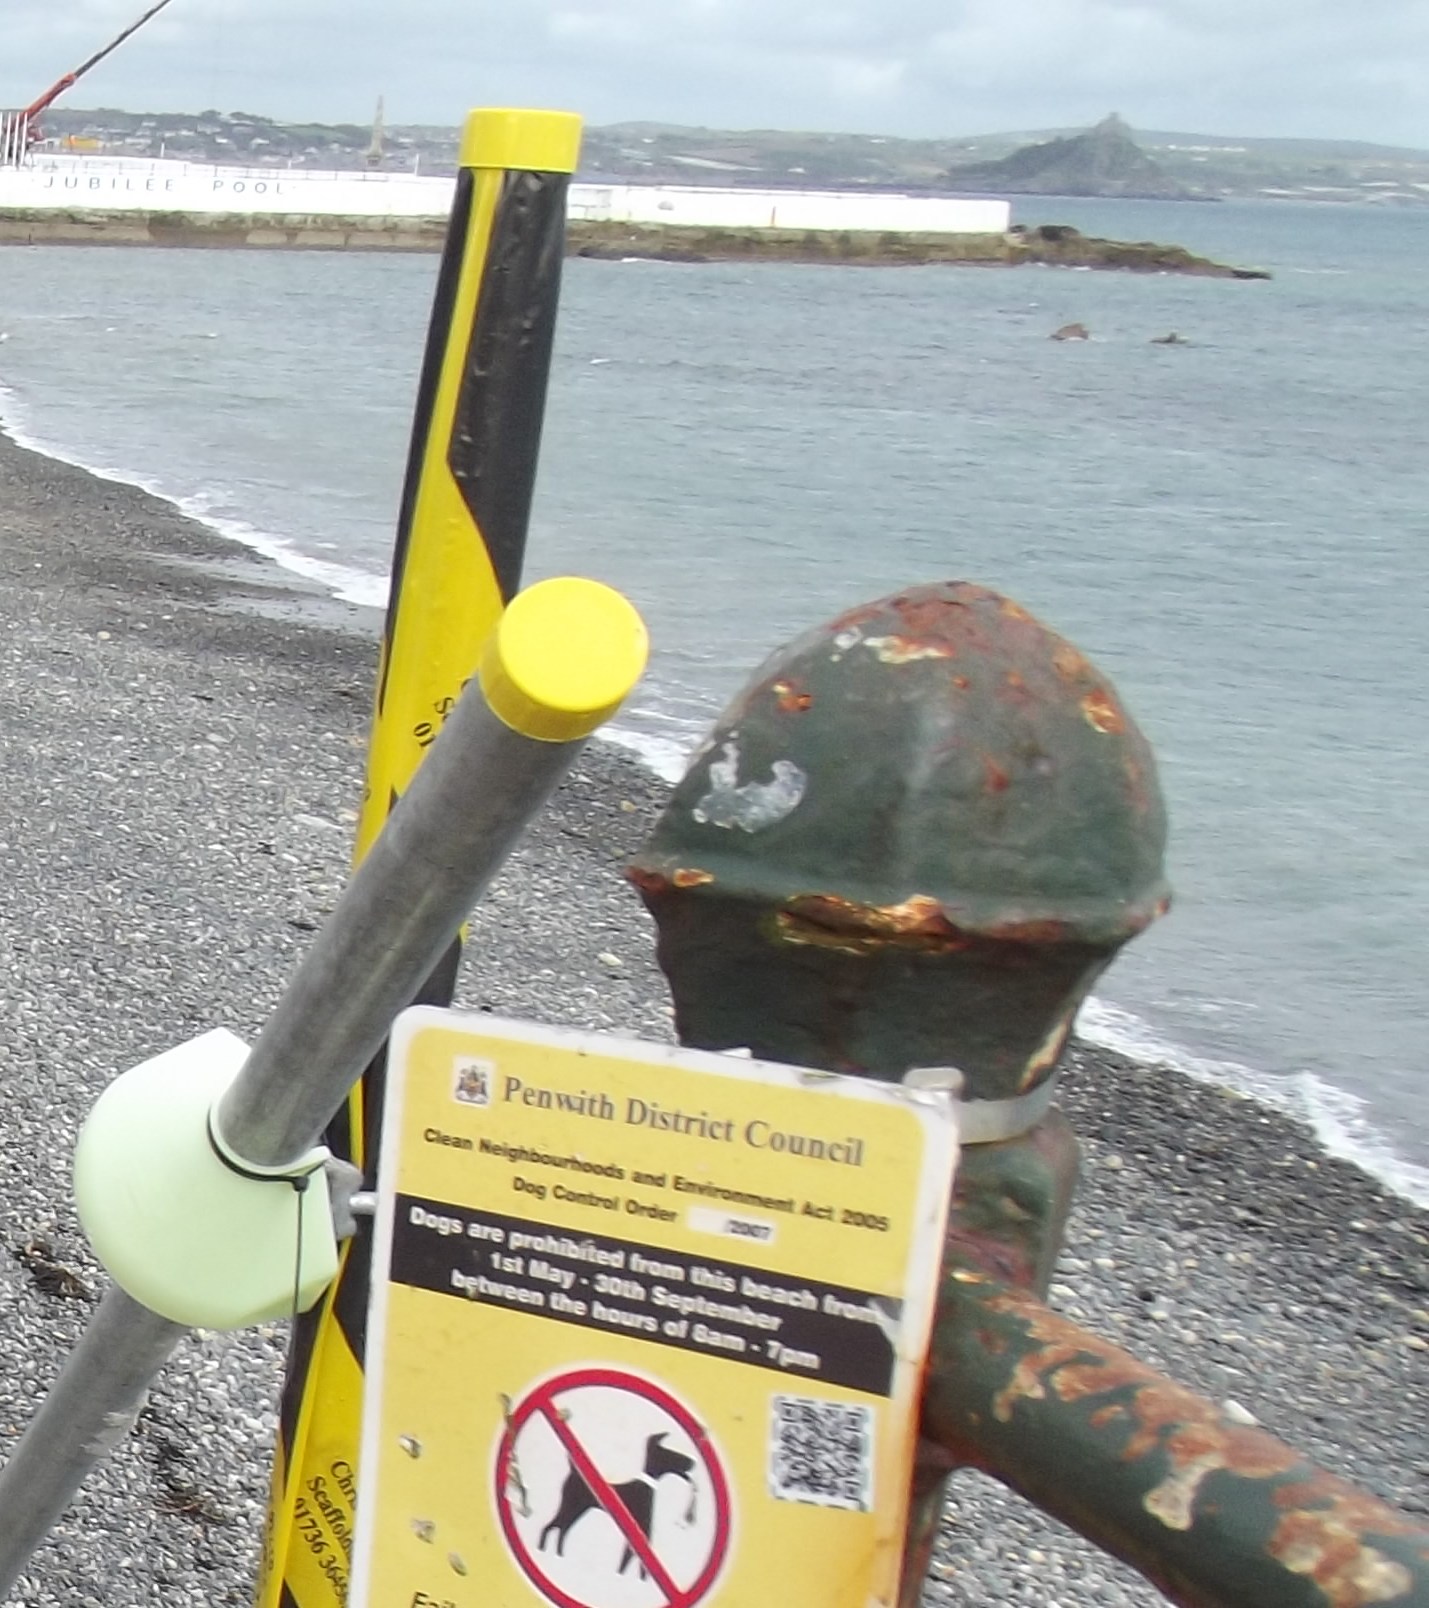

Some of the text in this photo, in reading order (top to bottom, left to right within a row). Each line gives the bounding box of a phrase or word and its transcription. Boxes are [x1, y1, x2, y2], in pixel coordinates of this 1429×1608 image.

[43, 176, 284, 195] JUBILEE POOL
[504, 1076, 865, 1167] Penwith District Council
[424, 1128, 890, 1232] Clean Neighbourhoods and Environment Act 2005
[513, 1176, 547, 1200] Dog
[553, 1184, 619, 1212] Control
[625, 1198, 679, 1223] Order
[409, 1206, 881, 1325] Dogs are prohibited from this beach from
[490, 1250, 525, 1276] 1st
[528, 1258, 577, 1290] May
[593, 1272, 647, 1302] 30th
[650, 1285, 784, 1332] September
[450, 1268, 546, 1307] between
[549, 1291, 588, 1316] the
[590, 1300, 659, 1332] hours
[662, 1318, 690, 1340] of
[765, 1339, 822, 1370] 7pm
